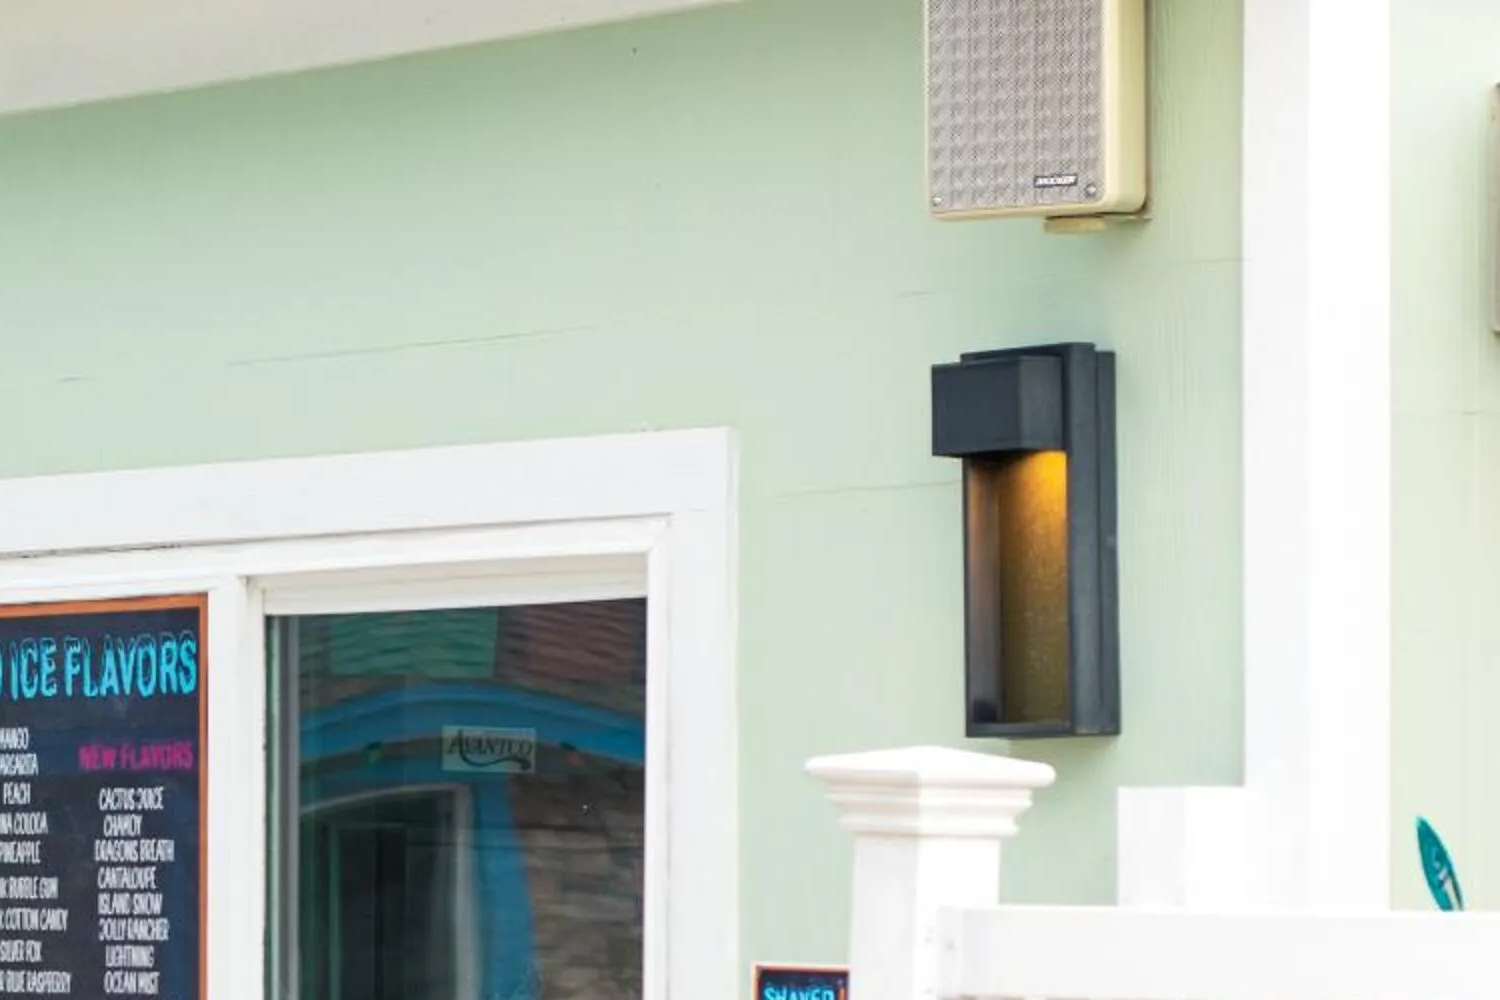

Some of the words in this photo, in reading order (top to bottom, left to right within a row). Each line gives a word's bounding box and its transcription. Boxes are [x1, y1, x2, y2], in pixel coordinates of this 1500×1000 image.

[10, 637, 57, 702] ICE
[64, 631, 198, 700] FLAVORS
[79, 743, 117, 771] NEW
[119, 740, 194, 772] FLAVORS
[3, 782, 31, 805] PEACH
[99, 787, 135, 811] CACTUS
[103, 814, 143, 838] CHAMOY
[94, 839, 139, 863] DRAGONS
[140, 838, 175, 863] BREATH
[8, 876, 39, 899] BUBBLE
[39, 877, 59, 900] GUM
[97, 866, 158, 890] CANTALOUPE
[98, 892, 131, 915] ISLAND
[132, 892, 163, 915] SNOW
[5, 907, 39, 931] COTTON
[40, 908, 69, 931] CANDY
[103, 970, 137, 994] OCEAN
